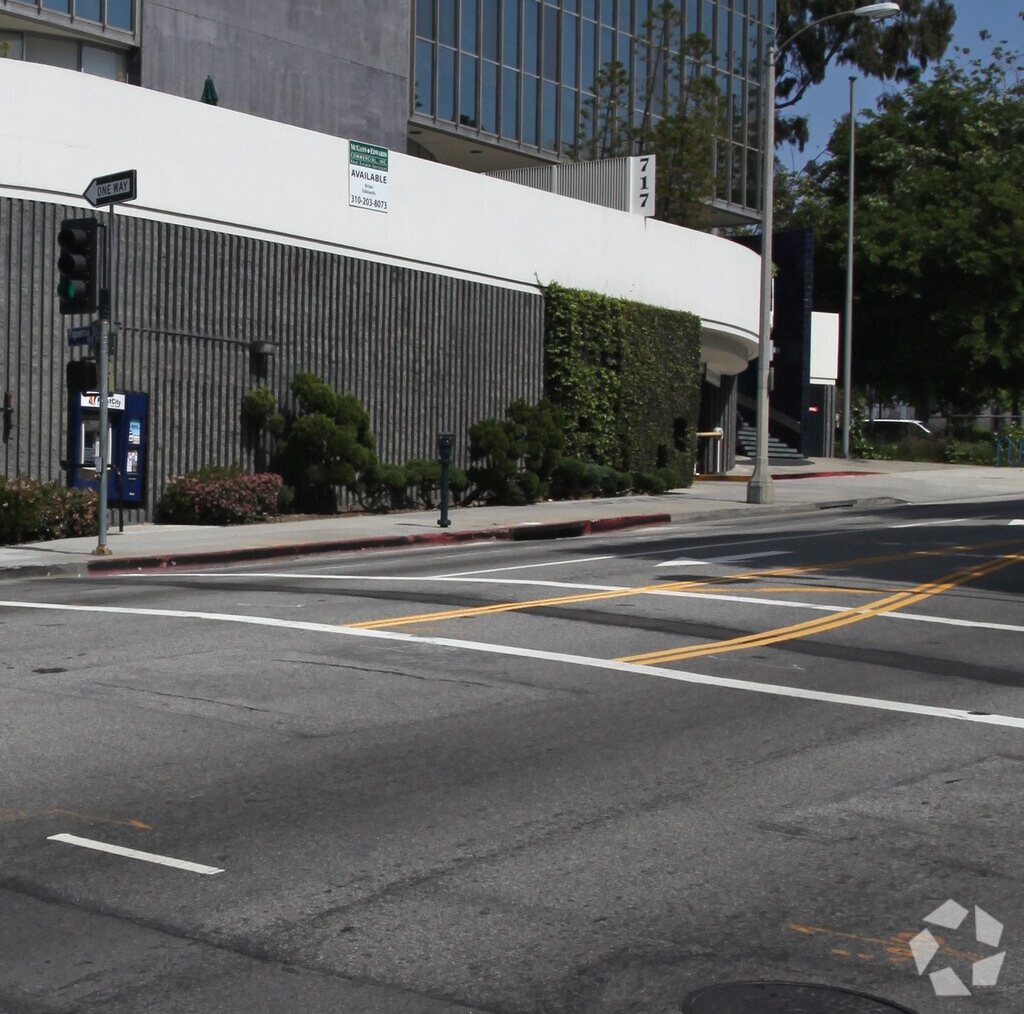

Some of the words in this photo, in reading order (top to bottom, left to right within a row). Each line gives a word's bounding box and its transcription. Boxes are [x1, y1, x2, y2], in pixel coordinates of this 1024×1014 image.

[351, 169, 387, 184] AVAILABLE
[639, 157, 649, 207] 717
[97, 185, 111, 197] ONE
[113, 180, 128, 193] WAY
[351, 194, 387, 210] 310-203-8073
